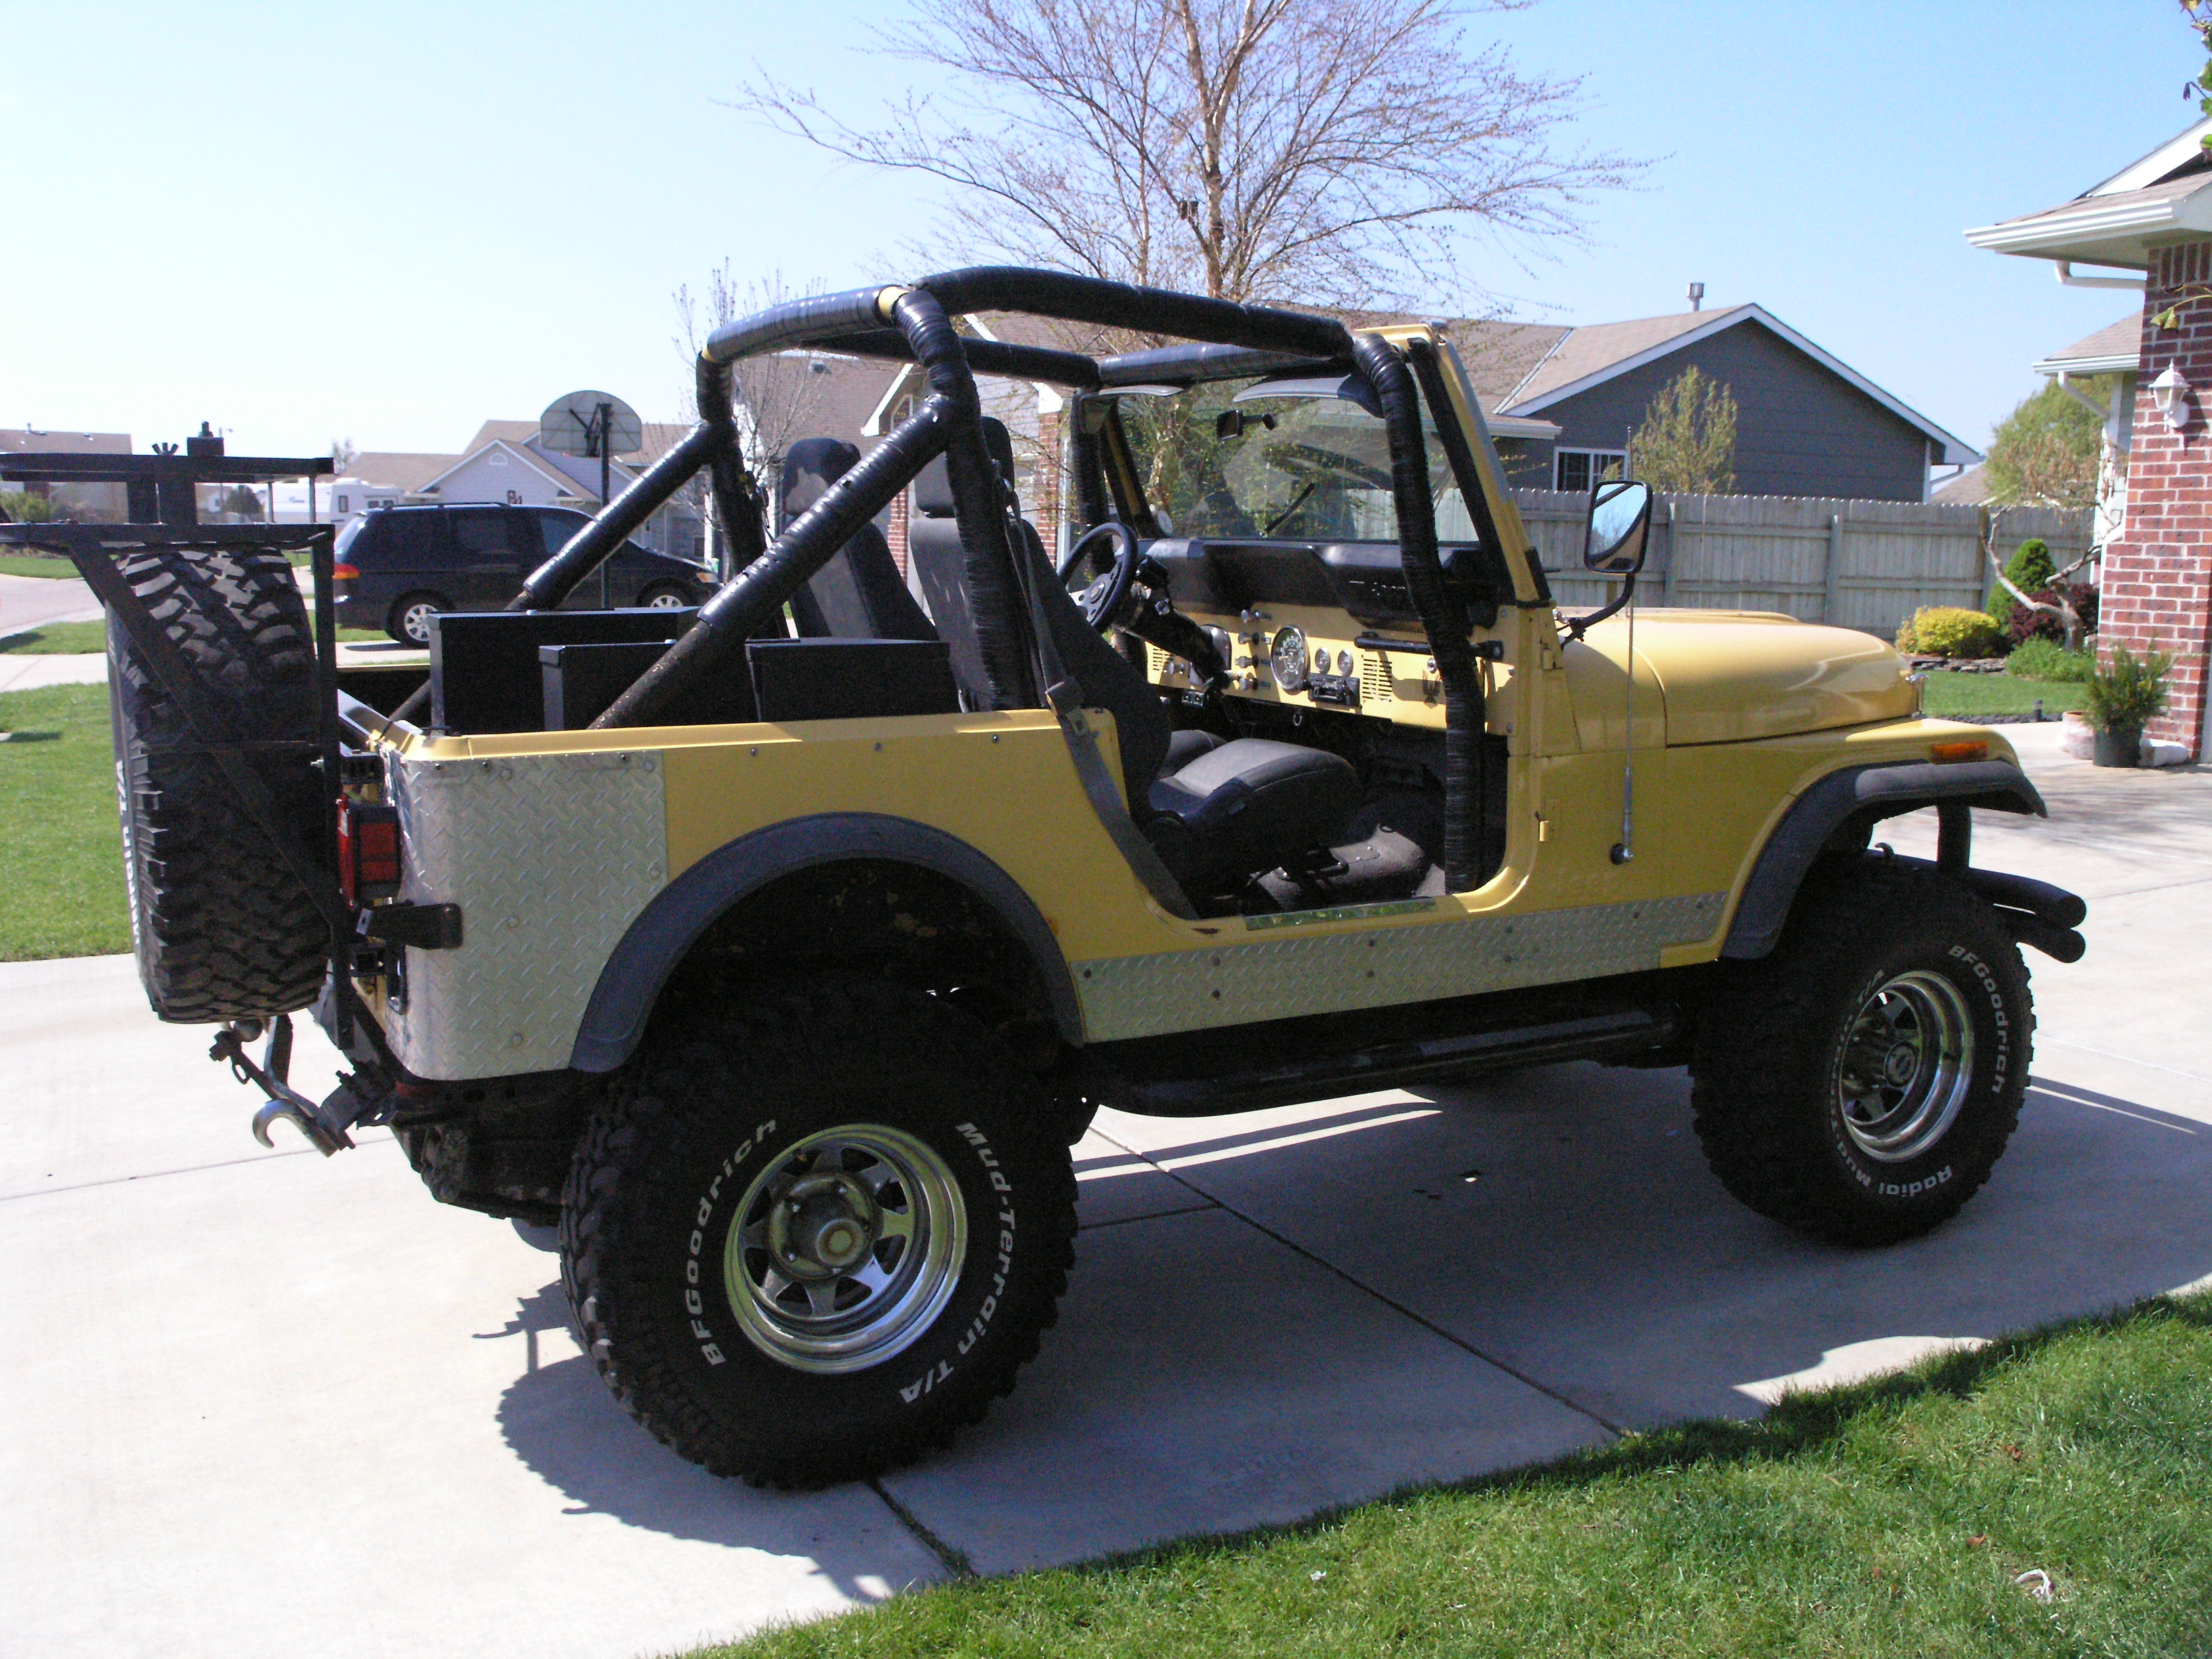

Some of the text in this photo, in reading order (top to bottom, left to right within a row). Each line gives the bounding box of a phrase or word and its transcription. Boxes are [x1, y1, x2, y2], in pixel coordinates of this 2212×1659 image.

[1948, 945, 2009, 1093] BFGoodrich
[1878, 1164, 1952, 1198] Radial
[685, 1119, 777, 1366] BFGoodrich
[899, 1359, 954, 1404] T/A
